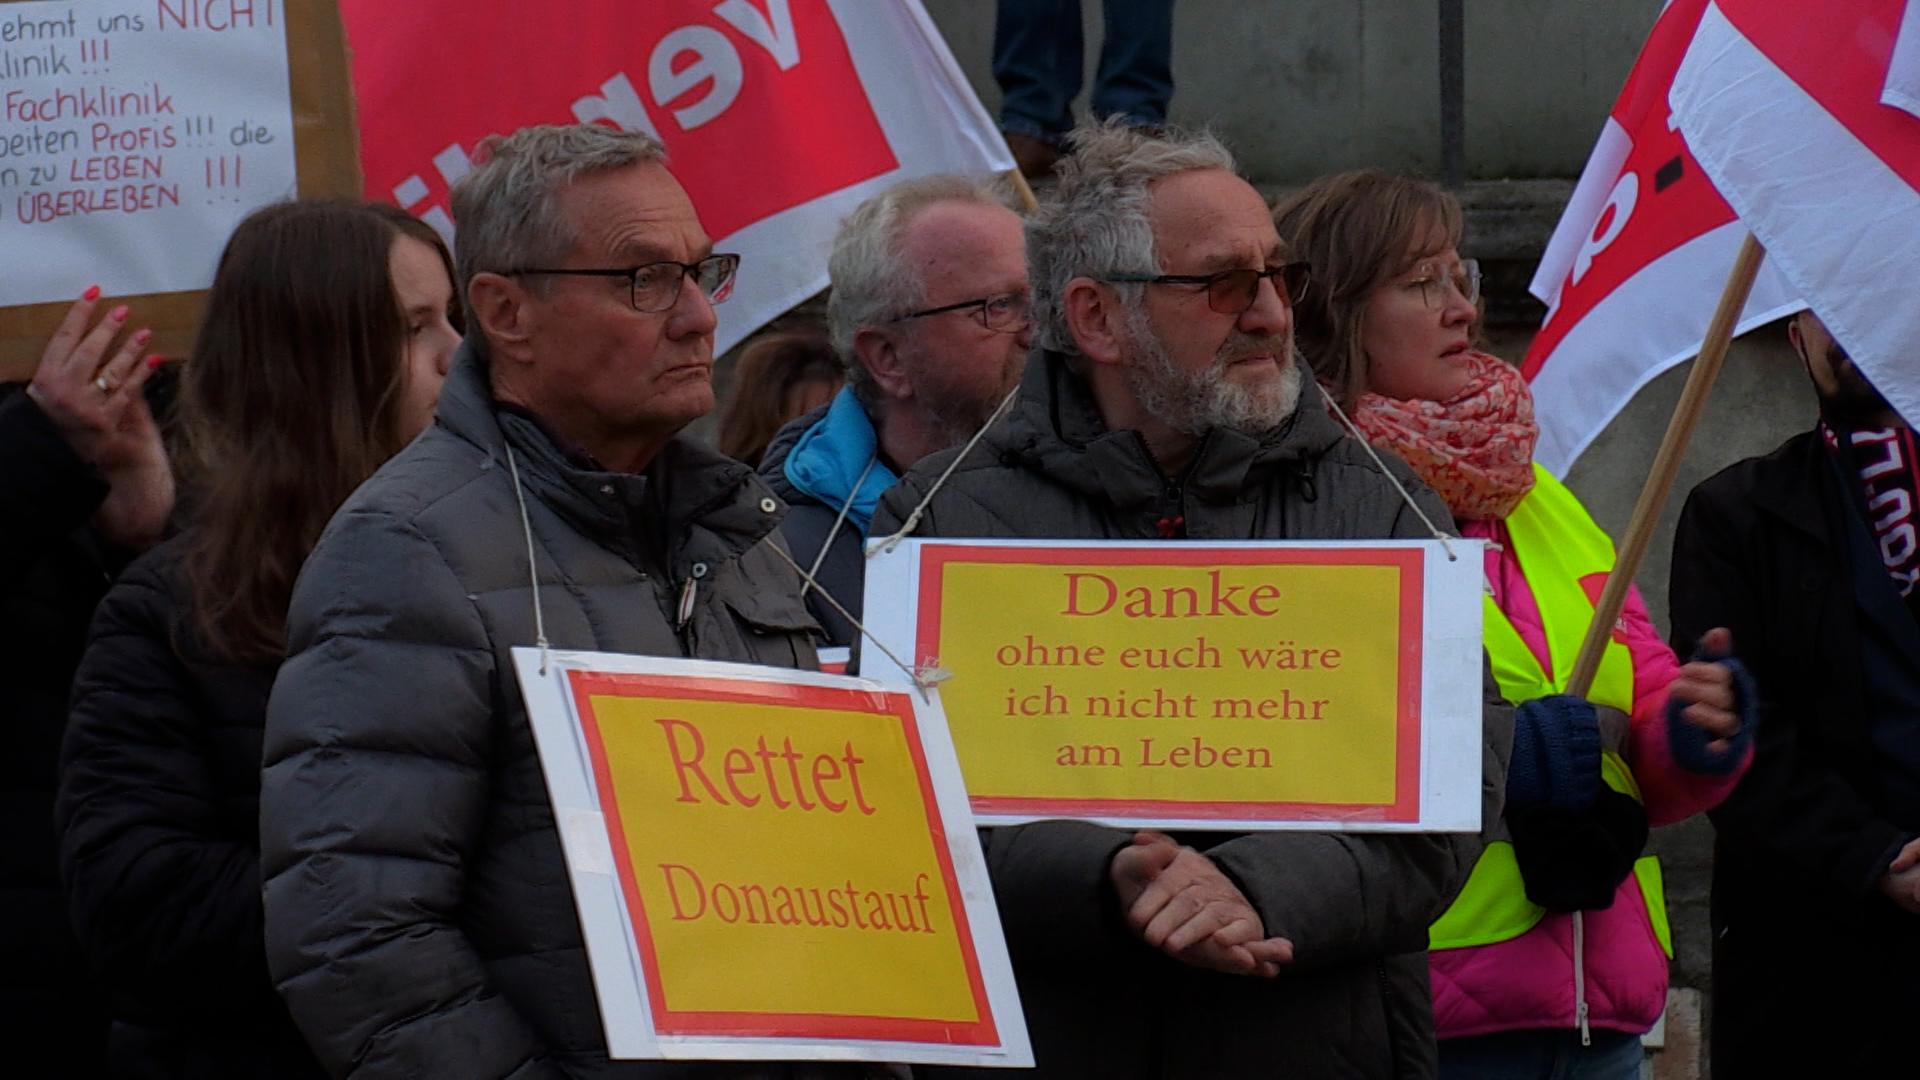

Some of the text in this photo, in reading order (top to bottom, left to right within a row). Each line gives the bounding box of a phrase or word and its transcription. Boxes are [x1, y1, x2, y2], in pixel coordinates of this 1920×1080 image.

[98, 15, 145, 33] uns
[0, 44, 71, 79] linik
[6, 82, 174, 121] Fachklinik
[230, 119, 273, 146] die
[29, 164, 56, 186] zu
[70, 155, 162, 182] LEBEN
[17, 183, 179, 224] ÜBERLEBEN
[1060, 570, 1282, 619] Danke
[996, 636, 1342, 670] ohne euch wäre
[1004, 685, 1330, 721] ich nicht mehr
[655, 718, 877, 816] Rettet
[1055, 737, 1273, 769] am Leben
[658, 863, 936, 934] Donaustauf
